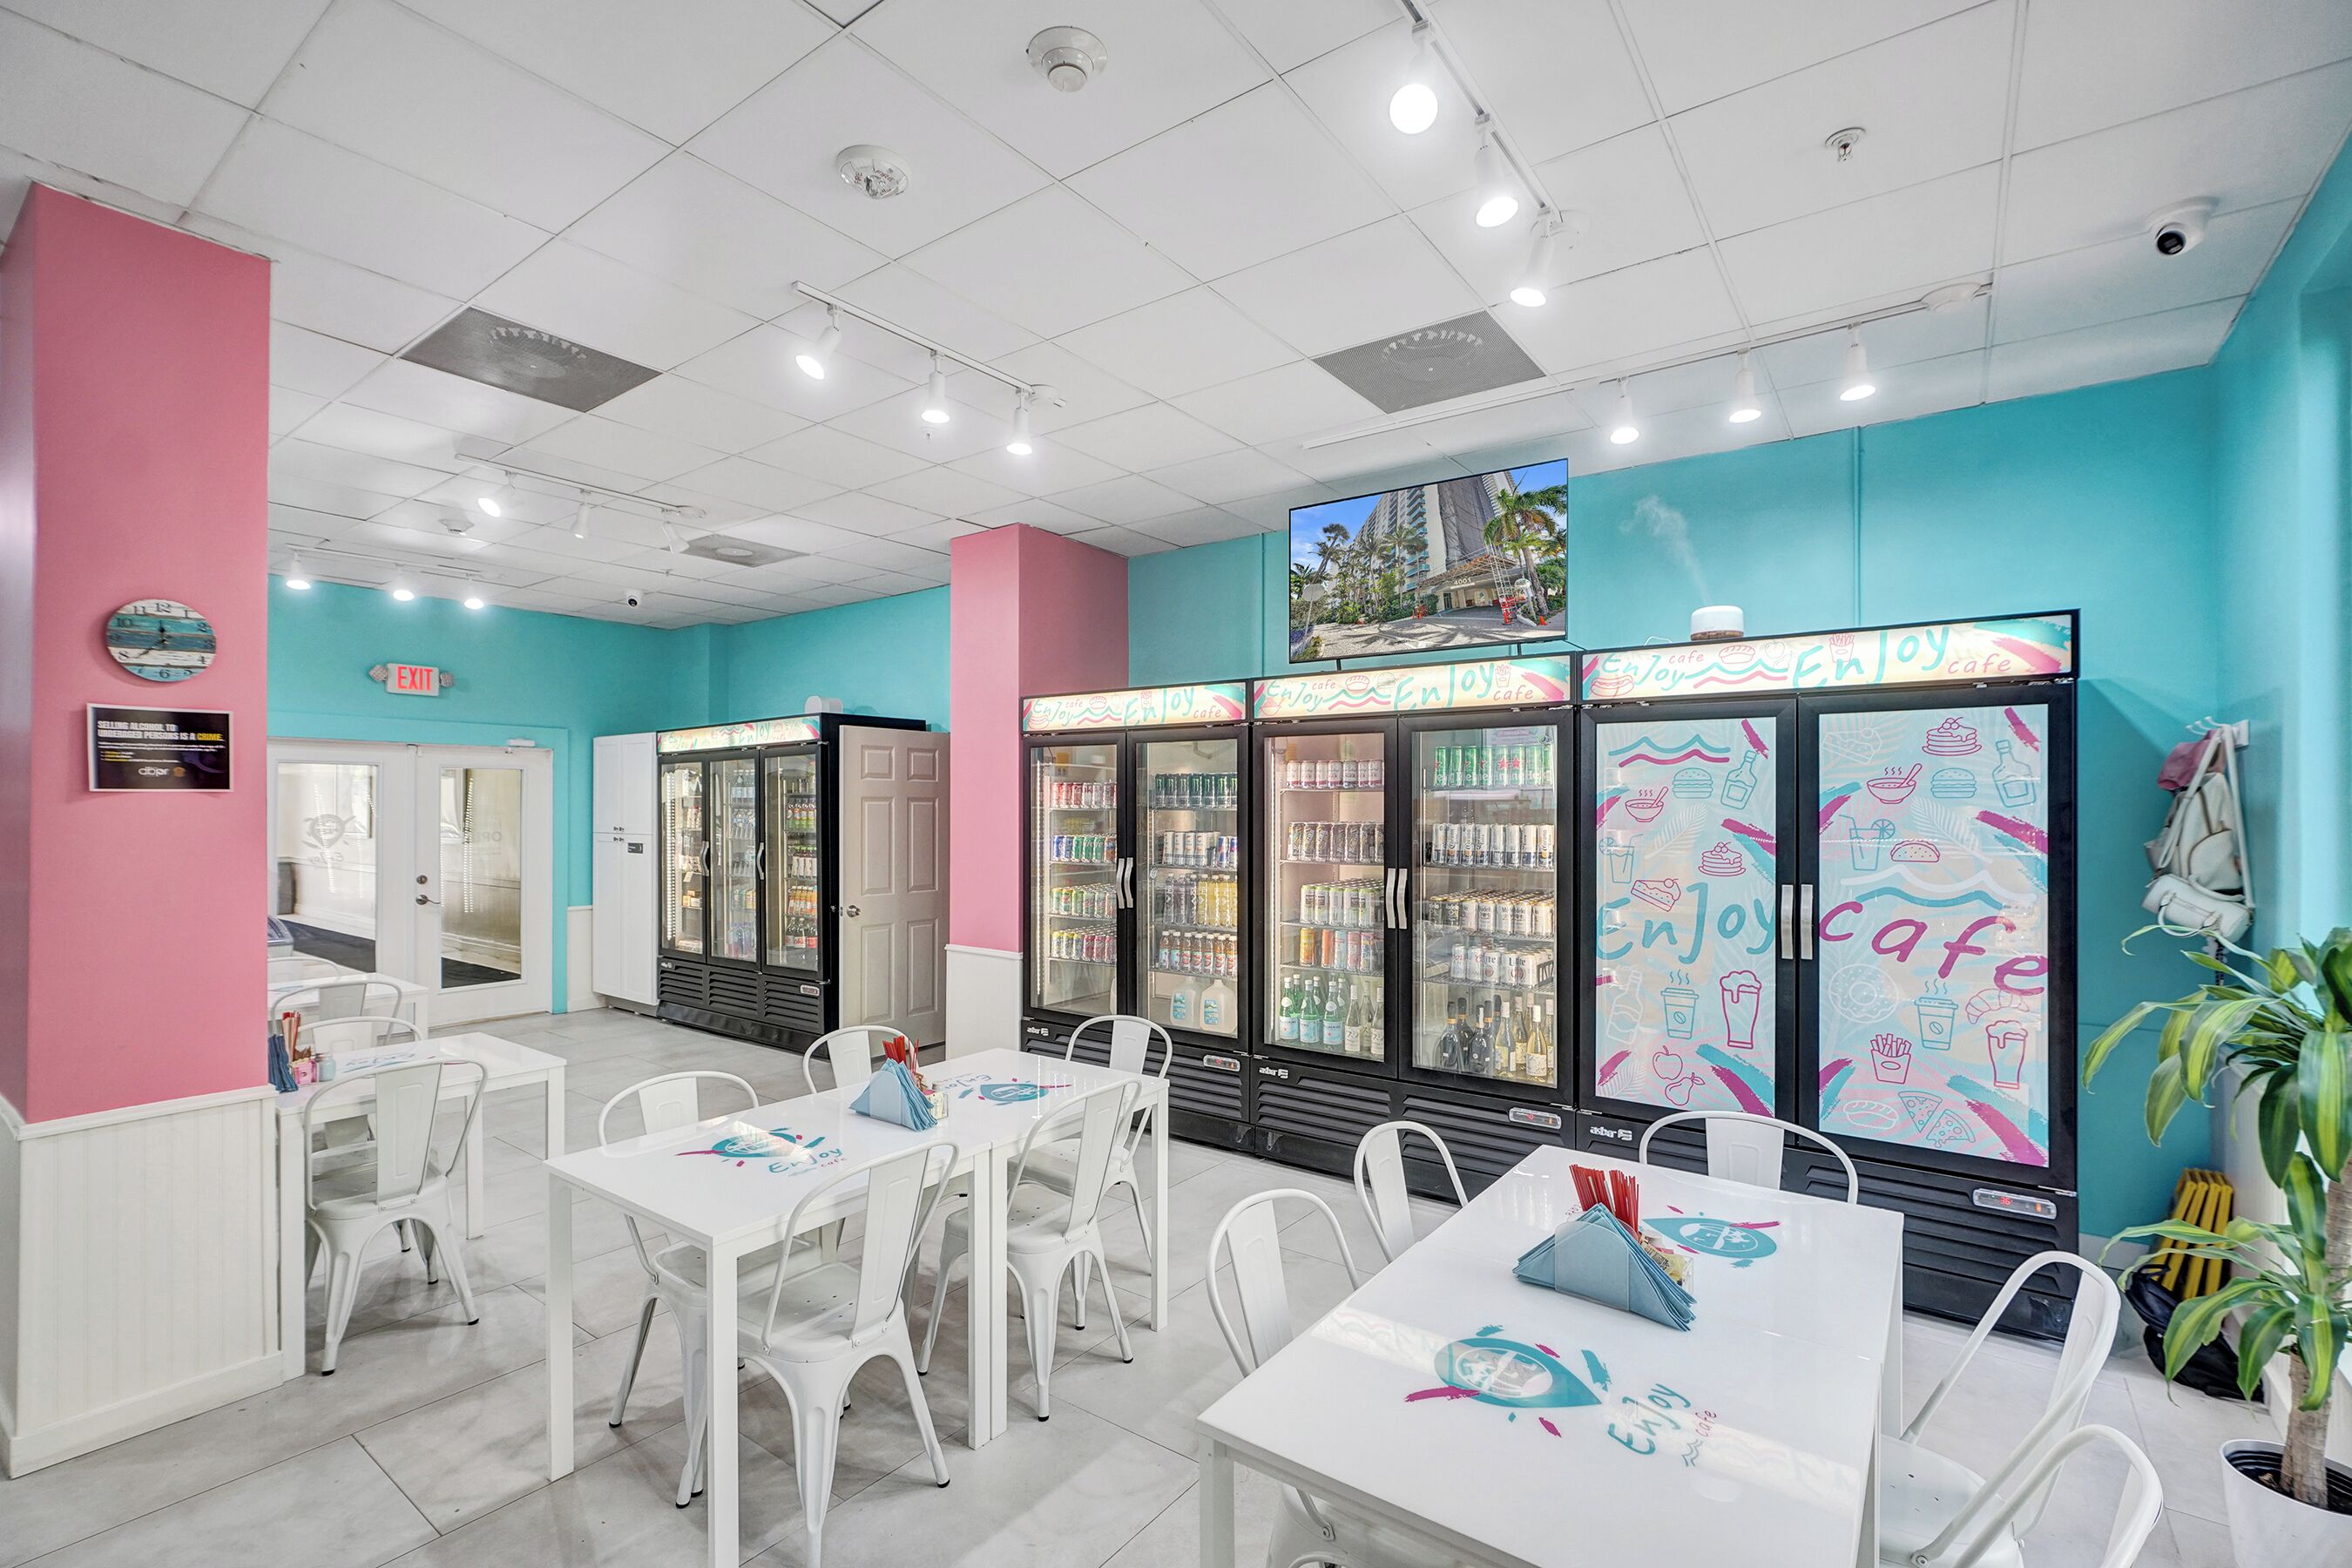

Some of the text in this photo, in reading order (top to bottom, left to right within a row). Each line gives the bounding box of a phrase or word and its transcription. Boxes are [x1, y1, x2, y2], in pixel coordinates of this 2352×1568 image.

[133, 606, 146, 615] 11
[155, 603, 171, 613] 12
[117, 618, 132, 627] 10
[197, 622, 207, 632] 2
[198, 654, 210, 664] 4
[1668, 650, 1704, 664] cafe
[1948, 653, 2011, 673] cafe
[159, 669, 171, 679] 6
[396, 666, 433, 691] EXIT
[1311, 679, 1335, 690] cafe
[1493, 686, 1534, 700] cafe
[1064, 698, 1084, 709] cafe
[1193, 706, 1221, 719] cafe
[98, 720, 179, 732] SELLING ALCOHOL TO
[144, 731, 179, 740] PERSONS
[139, 767, 169, 777] dbpr
[1819, 901, 2049, 995] cafe
[1694, 1410, 1717, 1436] cafe
